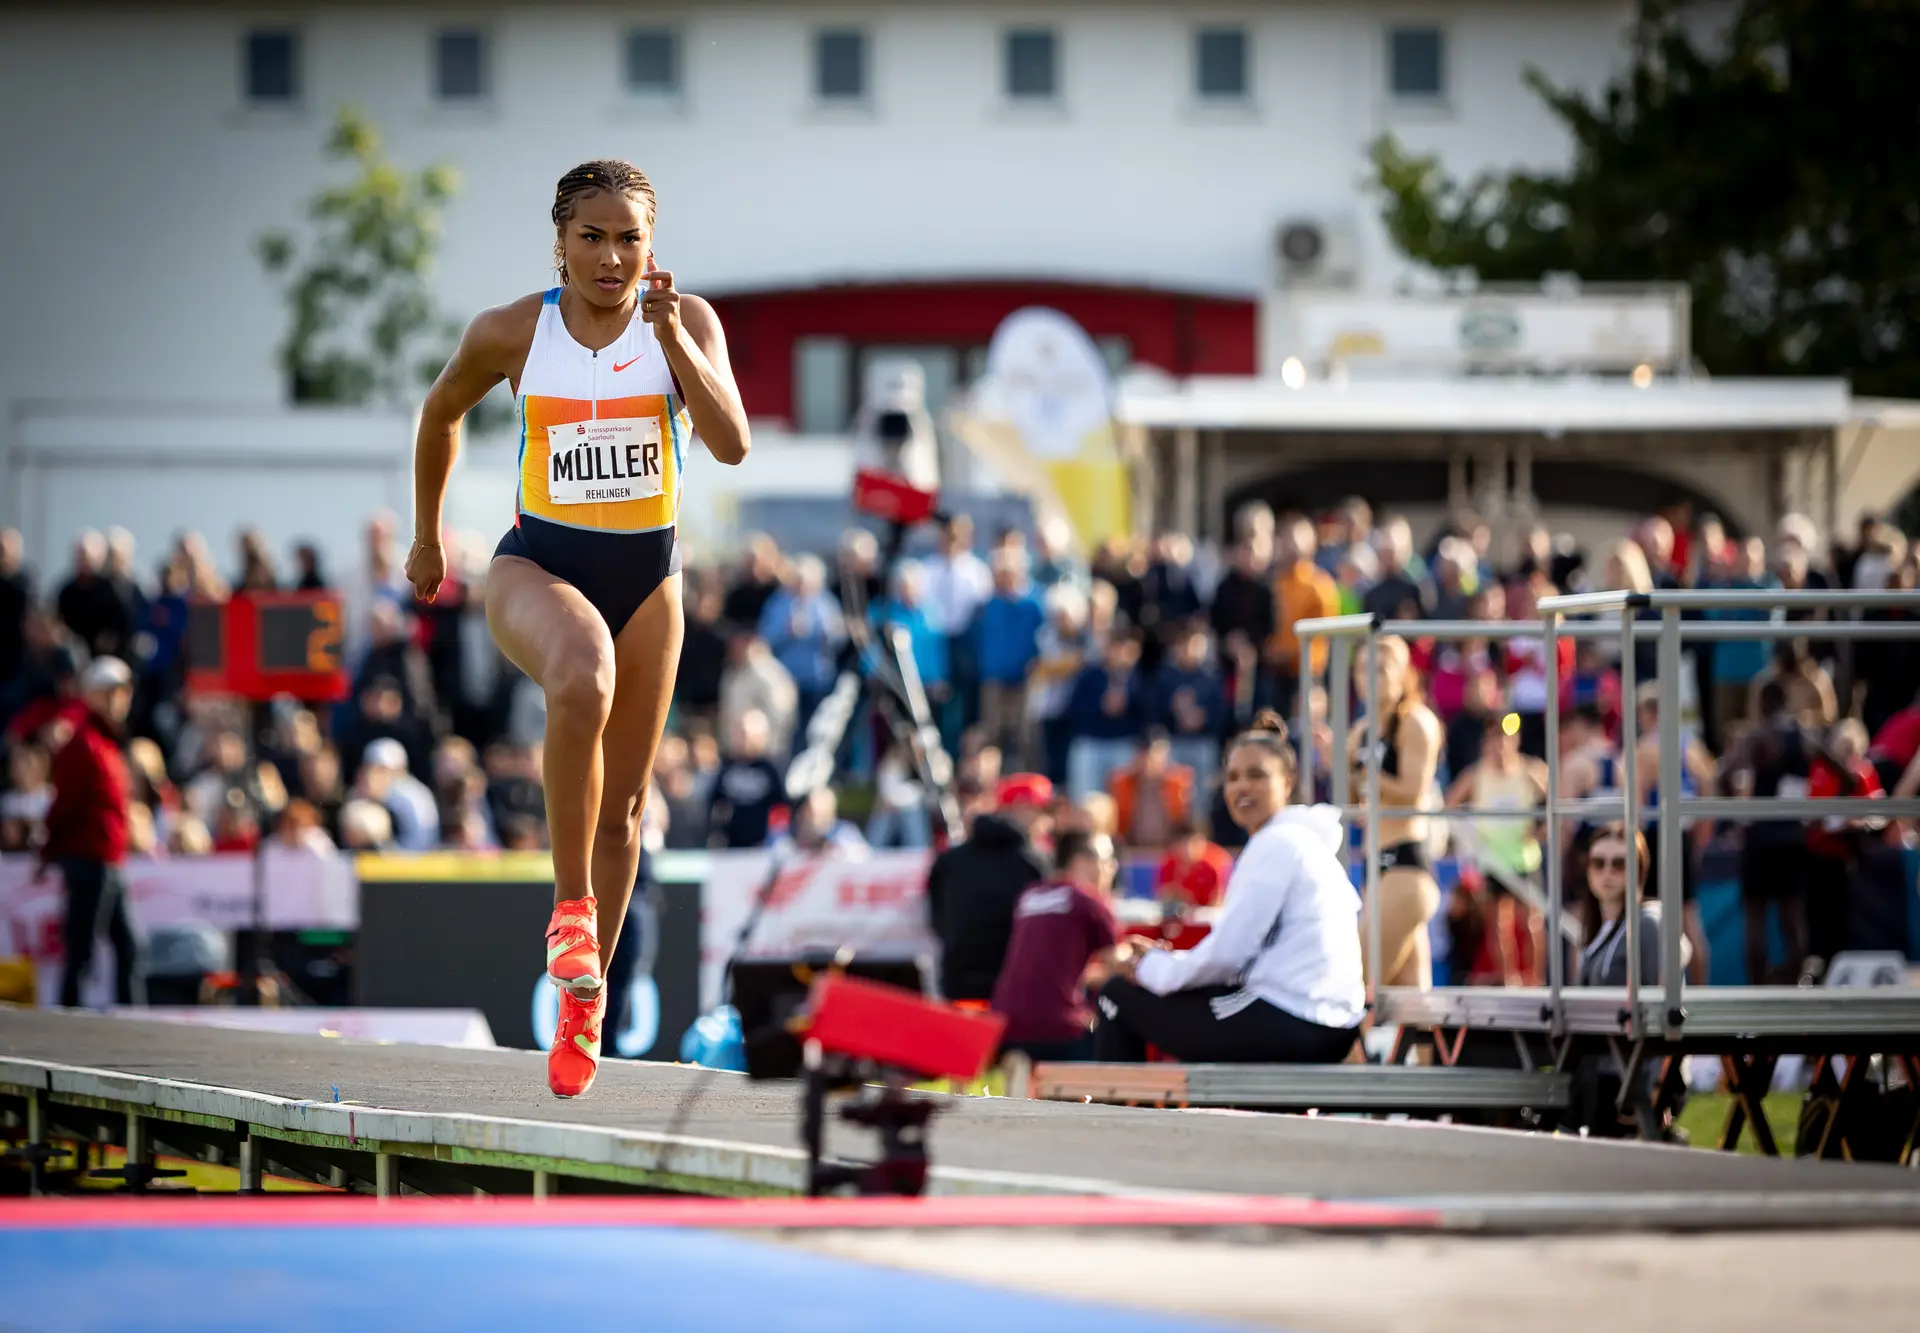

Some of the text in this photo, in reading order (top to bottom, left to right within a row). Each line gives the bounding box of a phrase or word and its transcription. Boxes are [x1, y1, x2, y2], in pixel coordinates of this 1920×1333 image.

[587, 426, 632, 434] Kreissparkasse
[553, 443, 659, 481] MÜLLER
[585, 487, 631, 499] REHLINGEN
